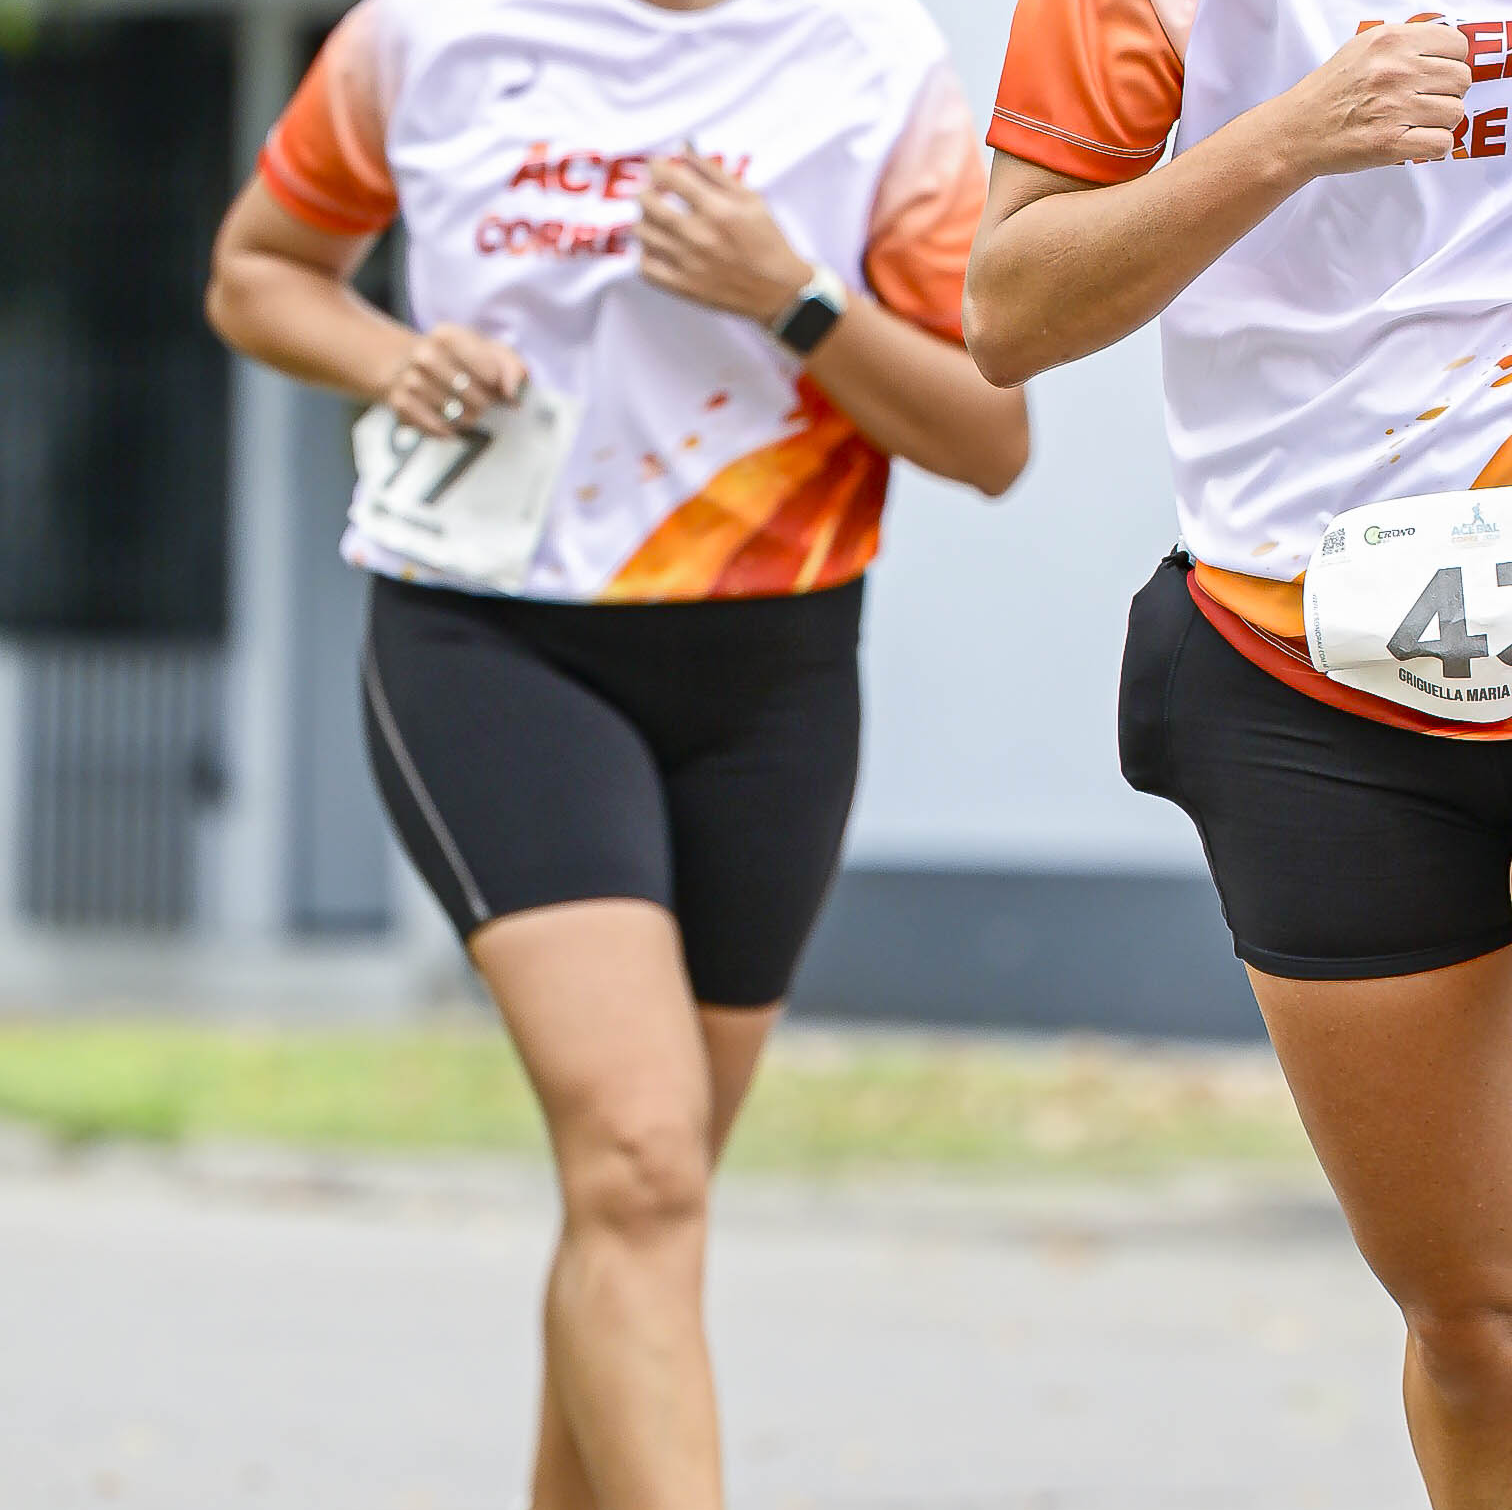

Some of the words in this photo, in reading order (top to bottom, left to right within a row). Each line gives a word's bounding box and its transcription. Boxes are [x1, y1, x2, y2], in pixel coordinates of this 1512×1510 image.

[508, 142, 752, 200] ACE
[1398, 667, 1464, 702] GRIGUELLA
[1466, 684, 1511, 702] MARIA
